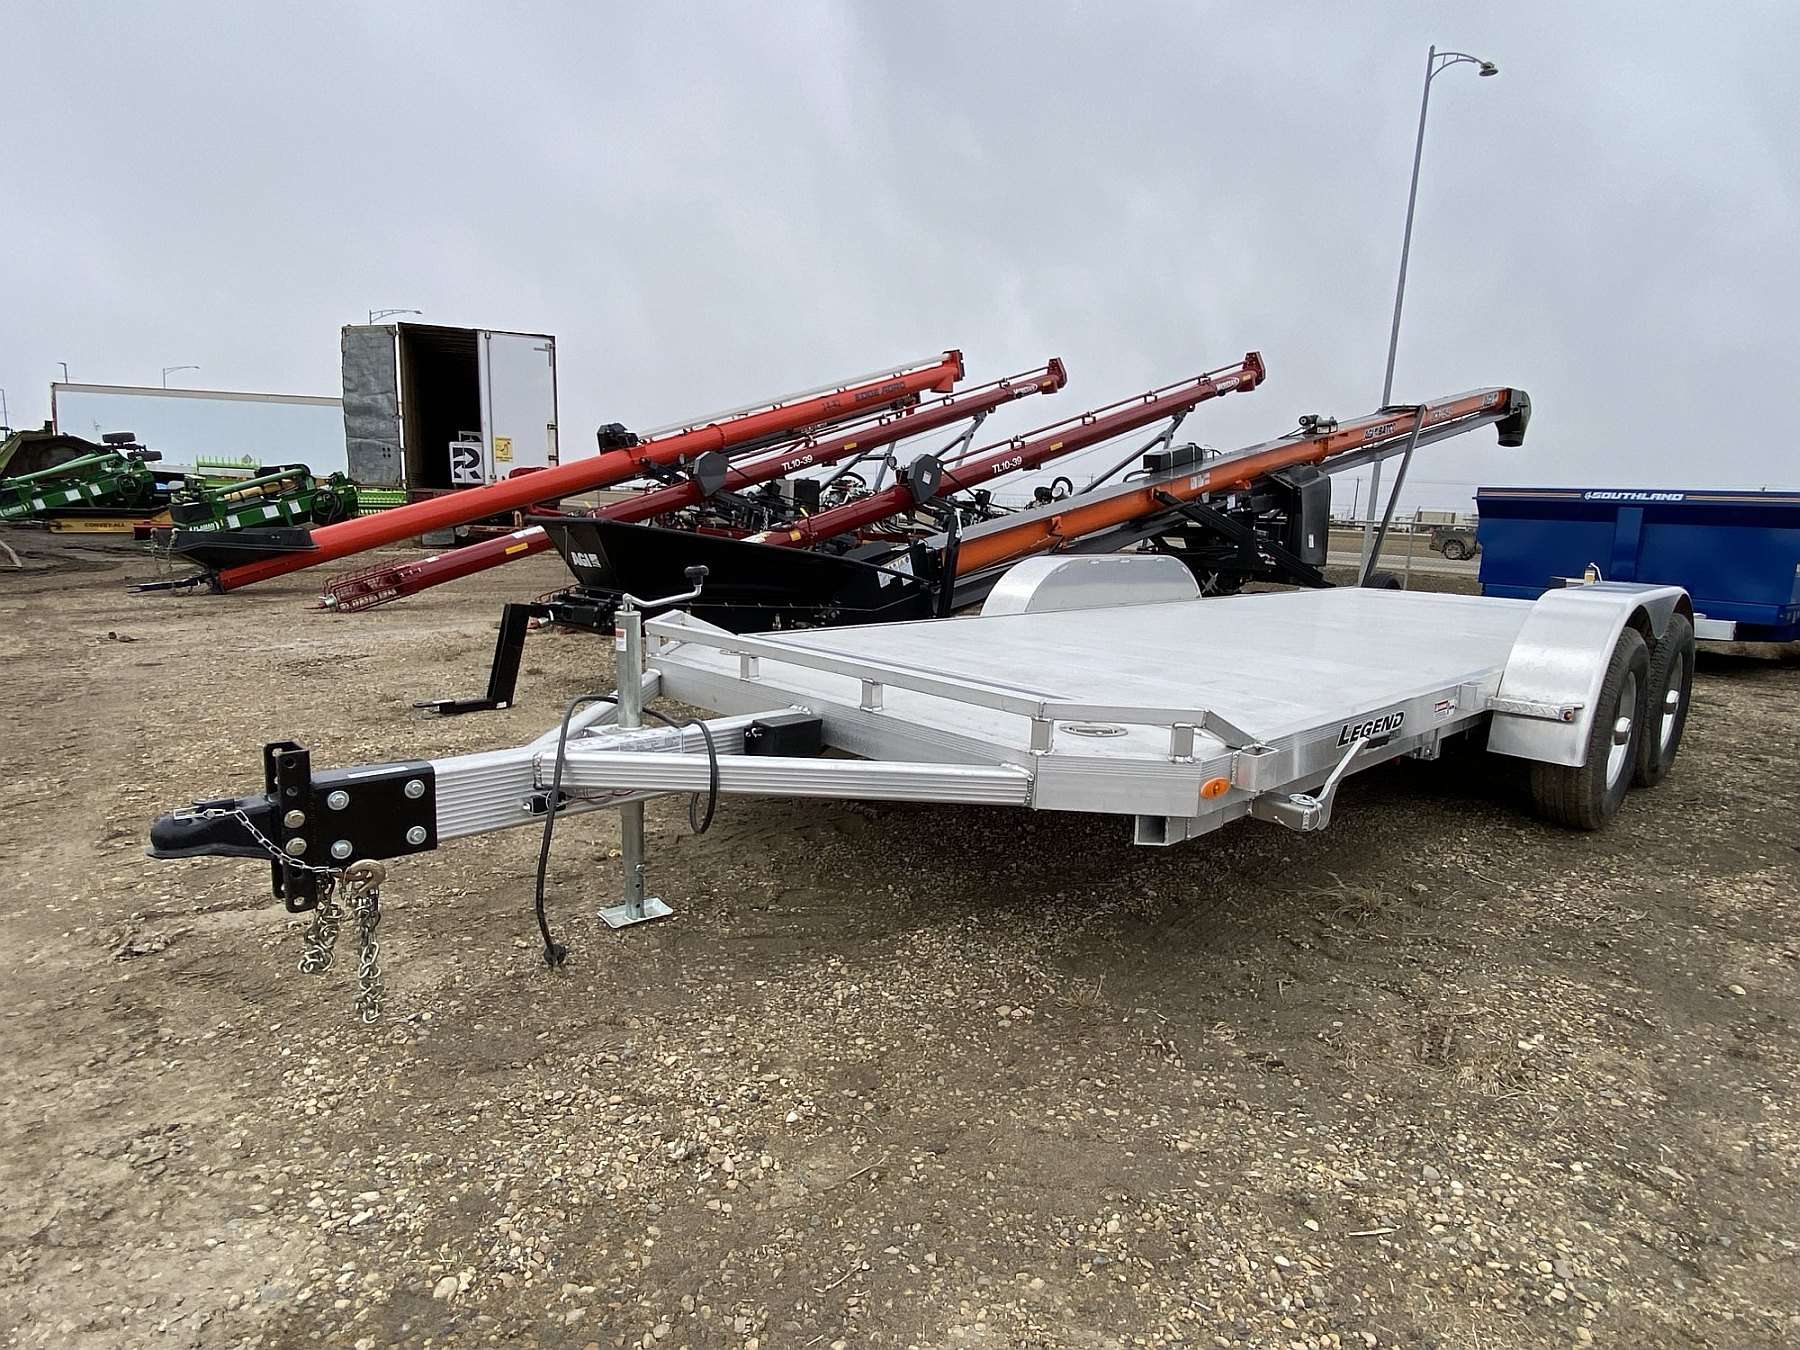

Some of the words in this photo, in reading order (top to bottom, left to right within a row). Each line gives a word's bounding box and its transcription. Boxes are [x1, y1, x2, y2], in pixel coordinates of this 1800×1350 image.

[781, 454, 813, 471] TL10-39
[991, 455, 1023, 474] TL10-39
[1590, 491, 1684, 501] SOUTHLAND
[1337, 711, 1405, 748] LEGEND
